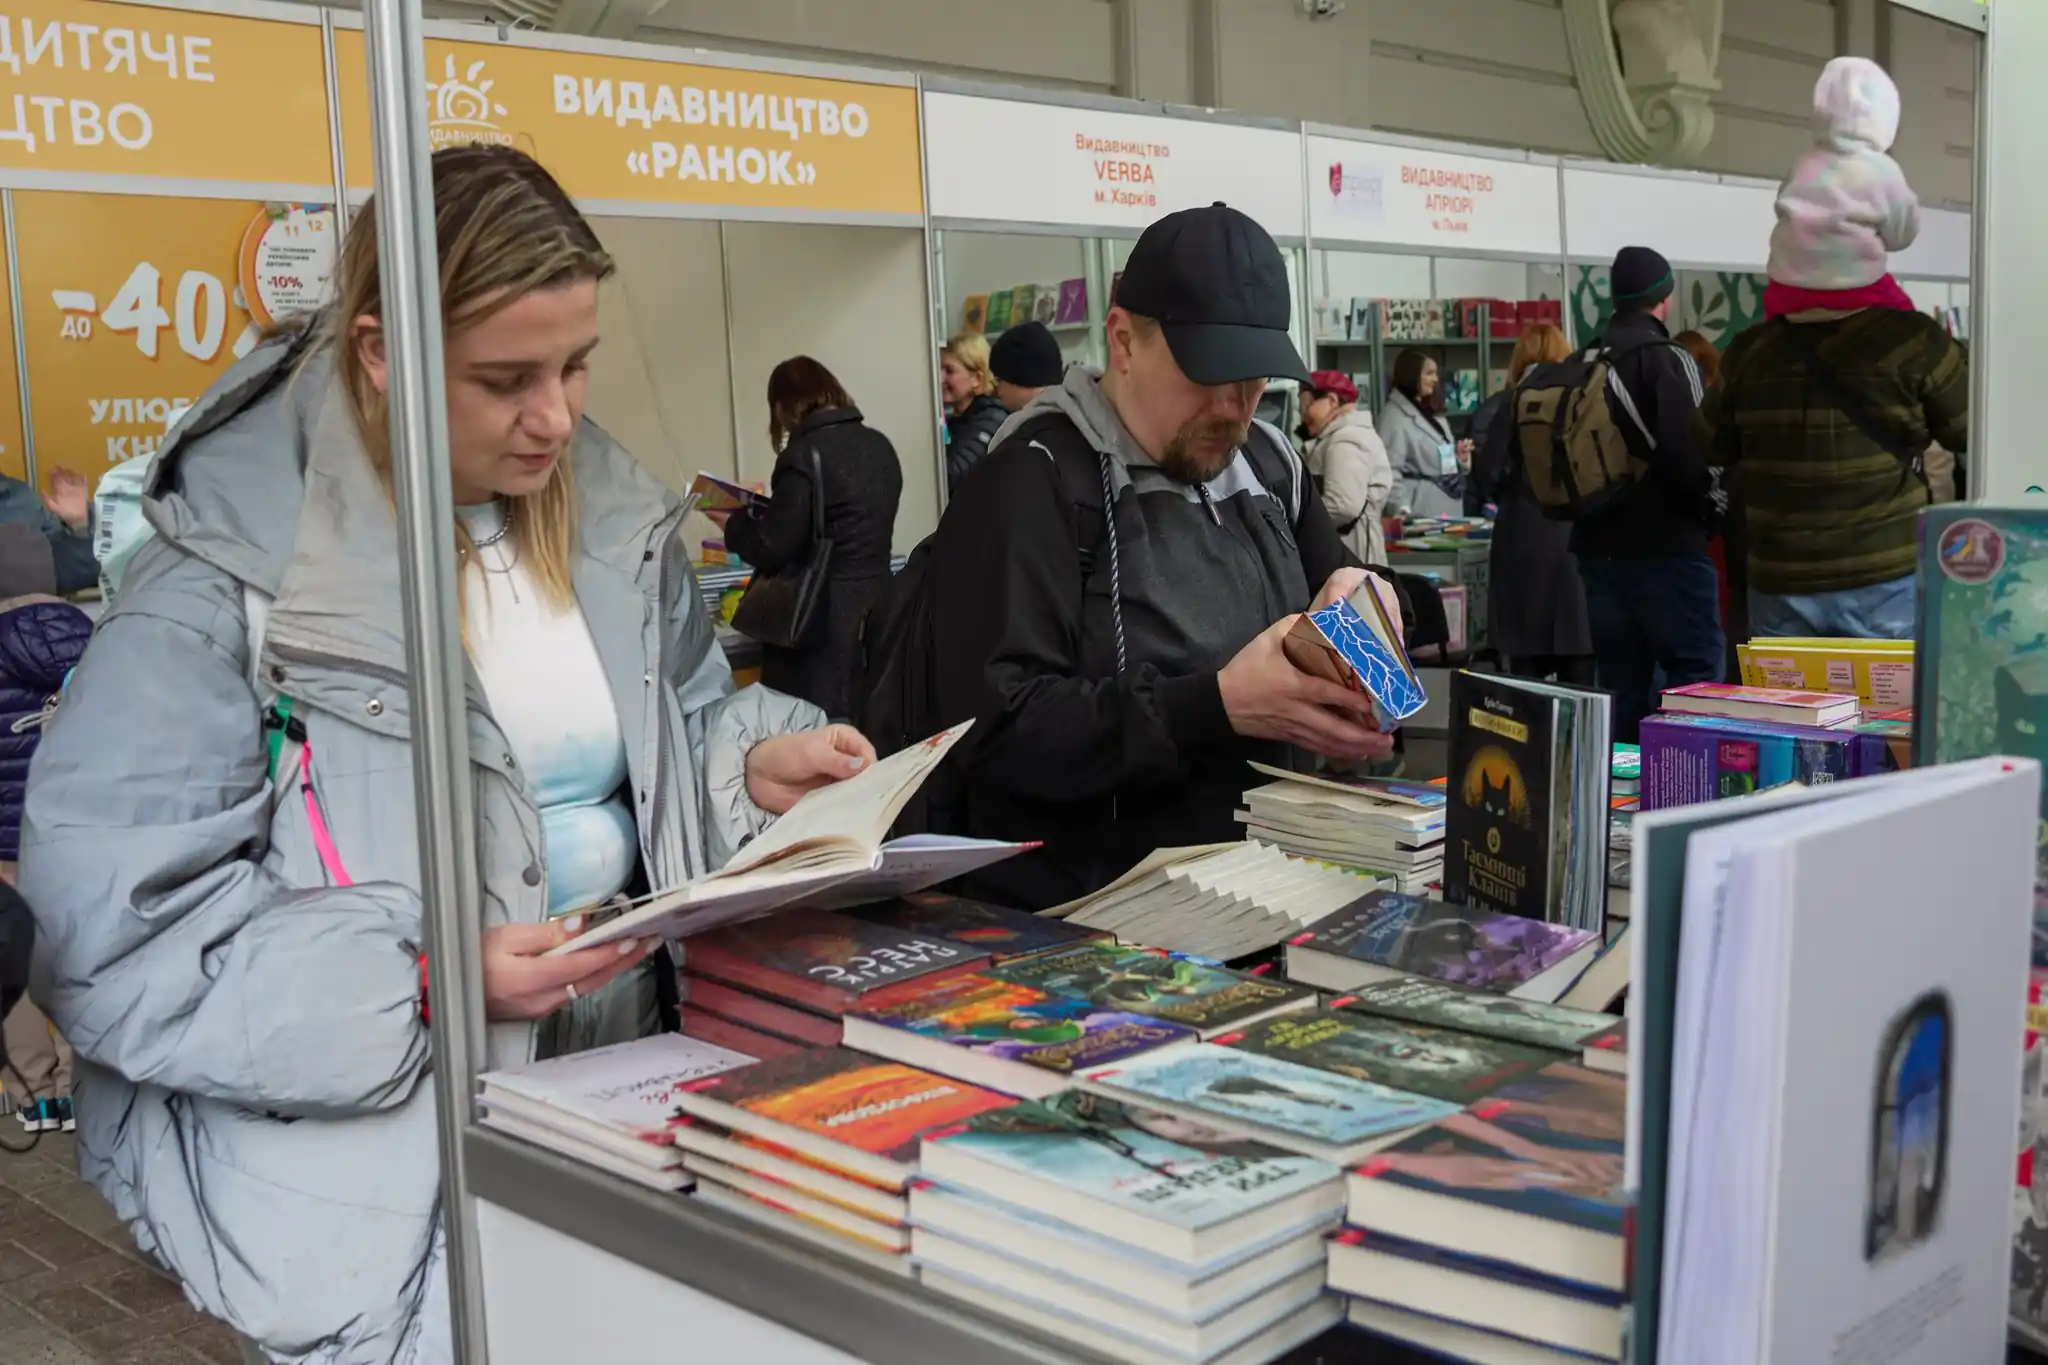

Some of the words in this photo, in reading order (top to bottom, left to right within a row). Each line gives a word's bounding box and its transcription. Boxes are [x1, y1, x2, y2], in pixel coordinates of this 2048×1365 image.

[553, 74, 869, 140] ВИДАВНИЦТВО
[1075, 133, 1170, 158] Видавництво
[627, 142, 817, 186] «РАНОК»
[1093, 160, 1154, 184] VERBA
[1401, 165, 1494, 194] ВИДАВНИЦТВО
[1111, 187, 1157, 208] Харків
[262, 275, 304, 290] -10%
[52, 261, 256, 360] -40
[60, 316, 92, 340] ДО
[106, 435, 164, 462] КН
[807, 940, 938, 980] НЕСС
[837, 945, 959, 986] ПАТРІК
